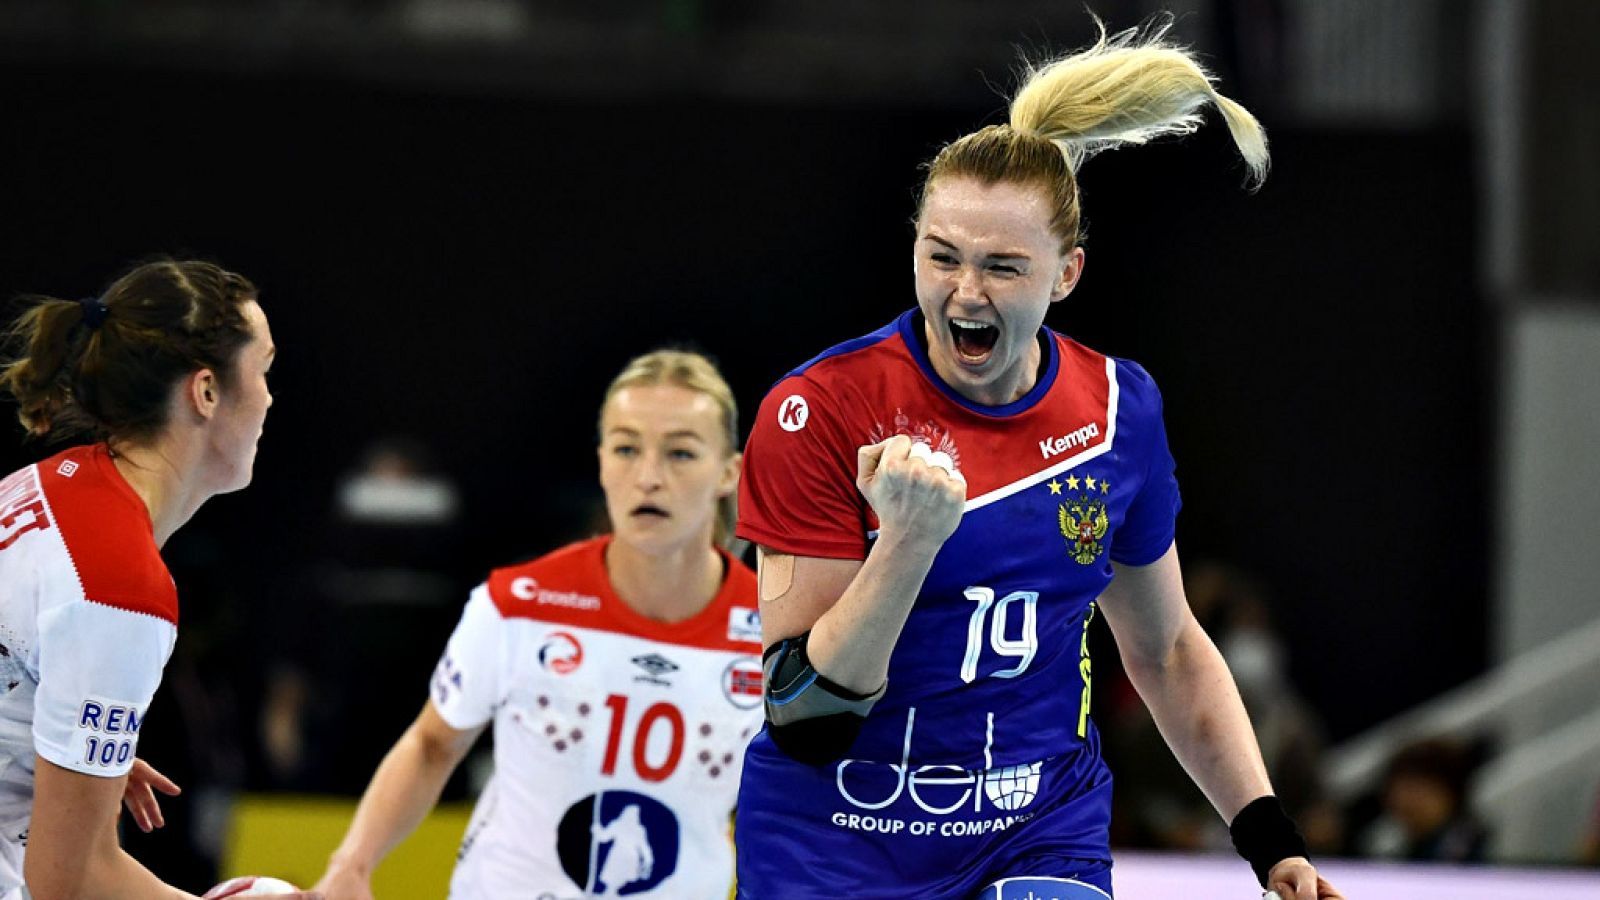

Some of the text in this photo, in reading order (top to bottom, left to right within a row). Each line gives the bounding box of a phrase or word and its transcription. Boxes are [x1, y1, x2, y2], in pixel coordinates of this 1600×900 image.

[1039, 422, 1100, 459] Kempa
[960, 586, 1040, 684] 19
[601, 693, 687, 784] 10
[831, 812, 906, 834] GROUP
[909, 820, 937, 836] OF
